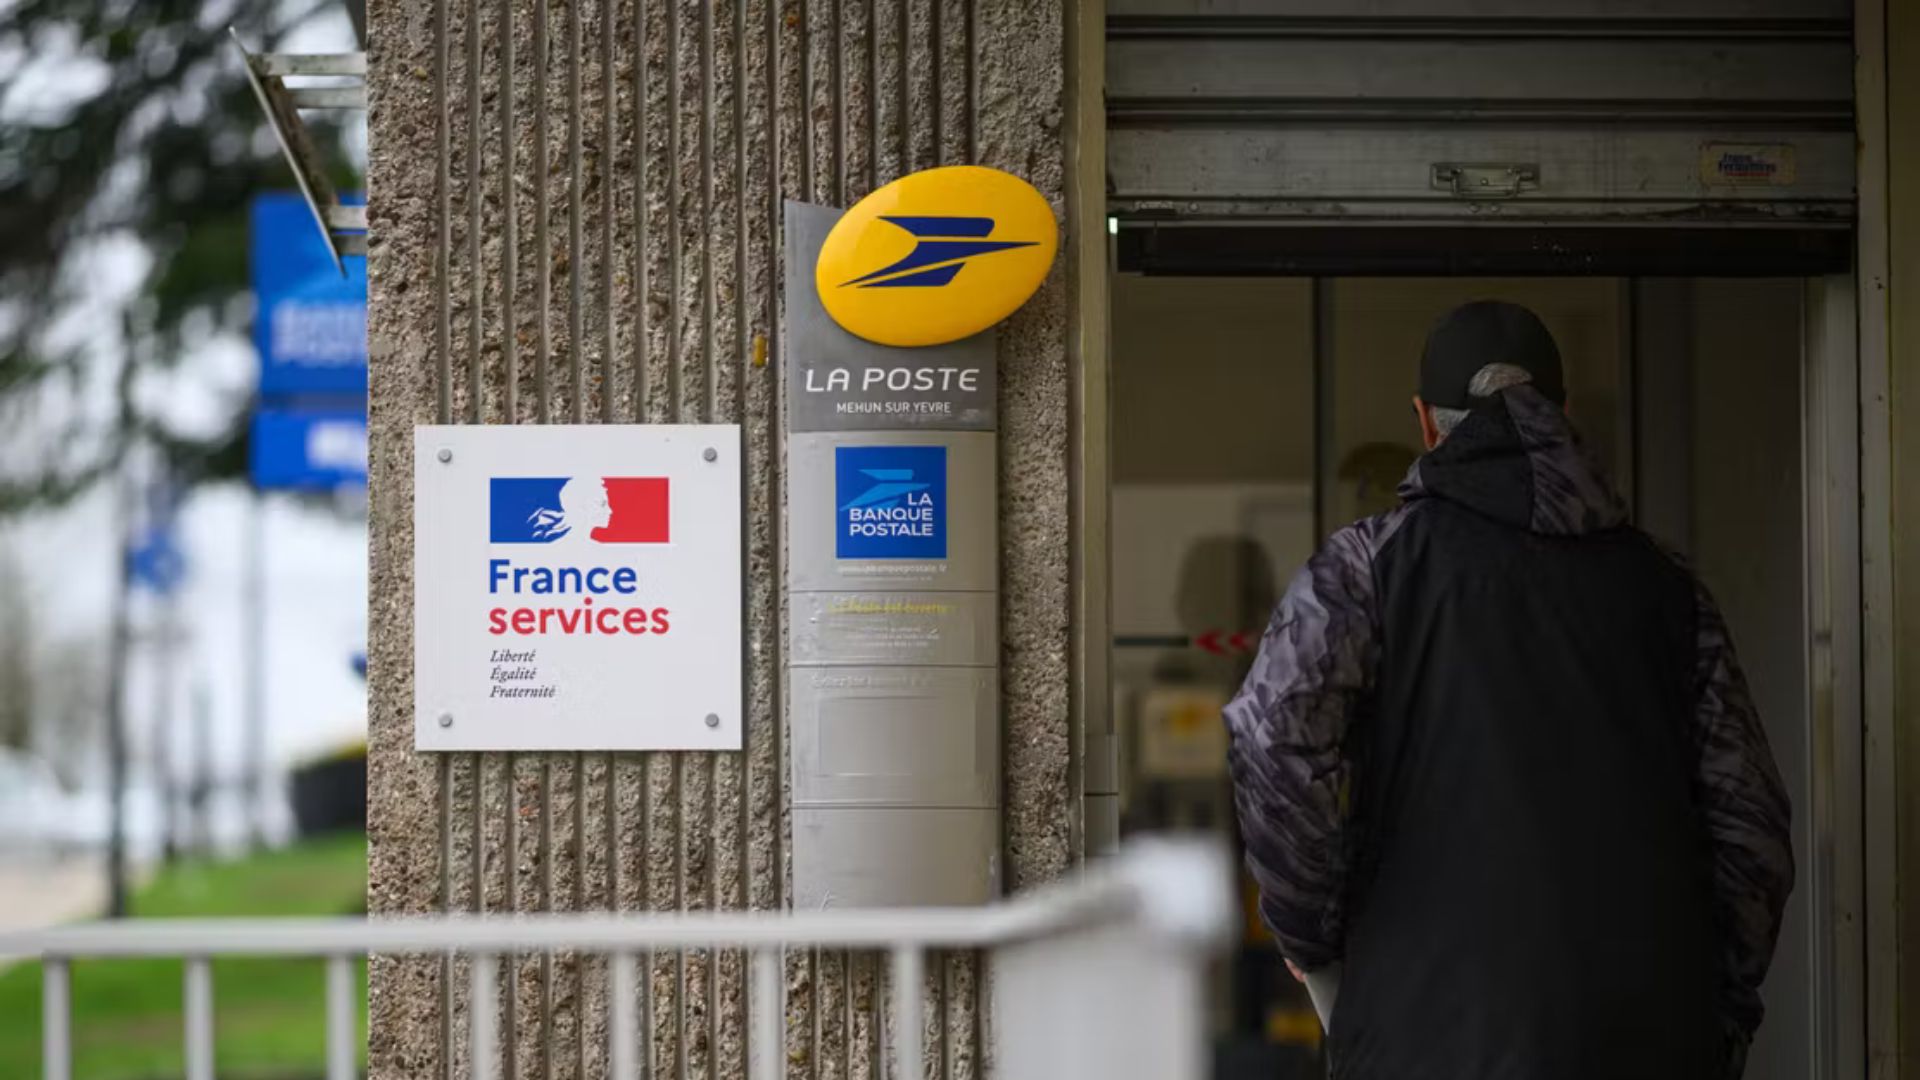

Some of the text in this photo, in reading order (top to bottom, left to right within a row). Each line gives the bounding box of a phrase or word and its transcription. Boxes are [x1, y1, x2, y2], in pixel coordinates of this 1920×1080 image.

[805, 367, 980, 392] LA POSTE
[836, 402, 951, 413] MEHUN SUR YEVRE
[907, 493, 933, 506] LA
[849, 508, 933, 522] BANQUE
[849, 523, 933, 537] POSTALE
[489, 559, 637, 594] France
[488, 597, 670, 635] services
[490, 649, 536, 663] Liberté
[490, 665, 536, 683] Égalité
[489, 684, 556, 698] Fraternité
